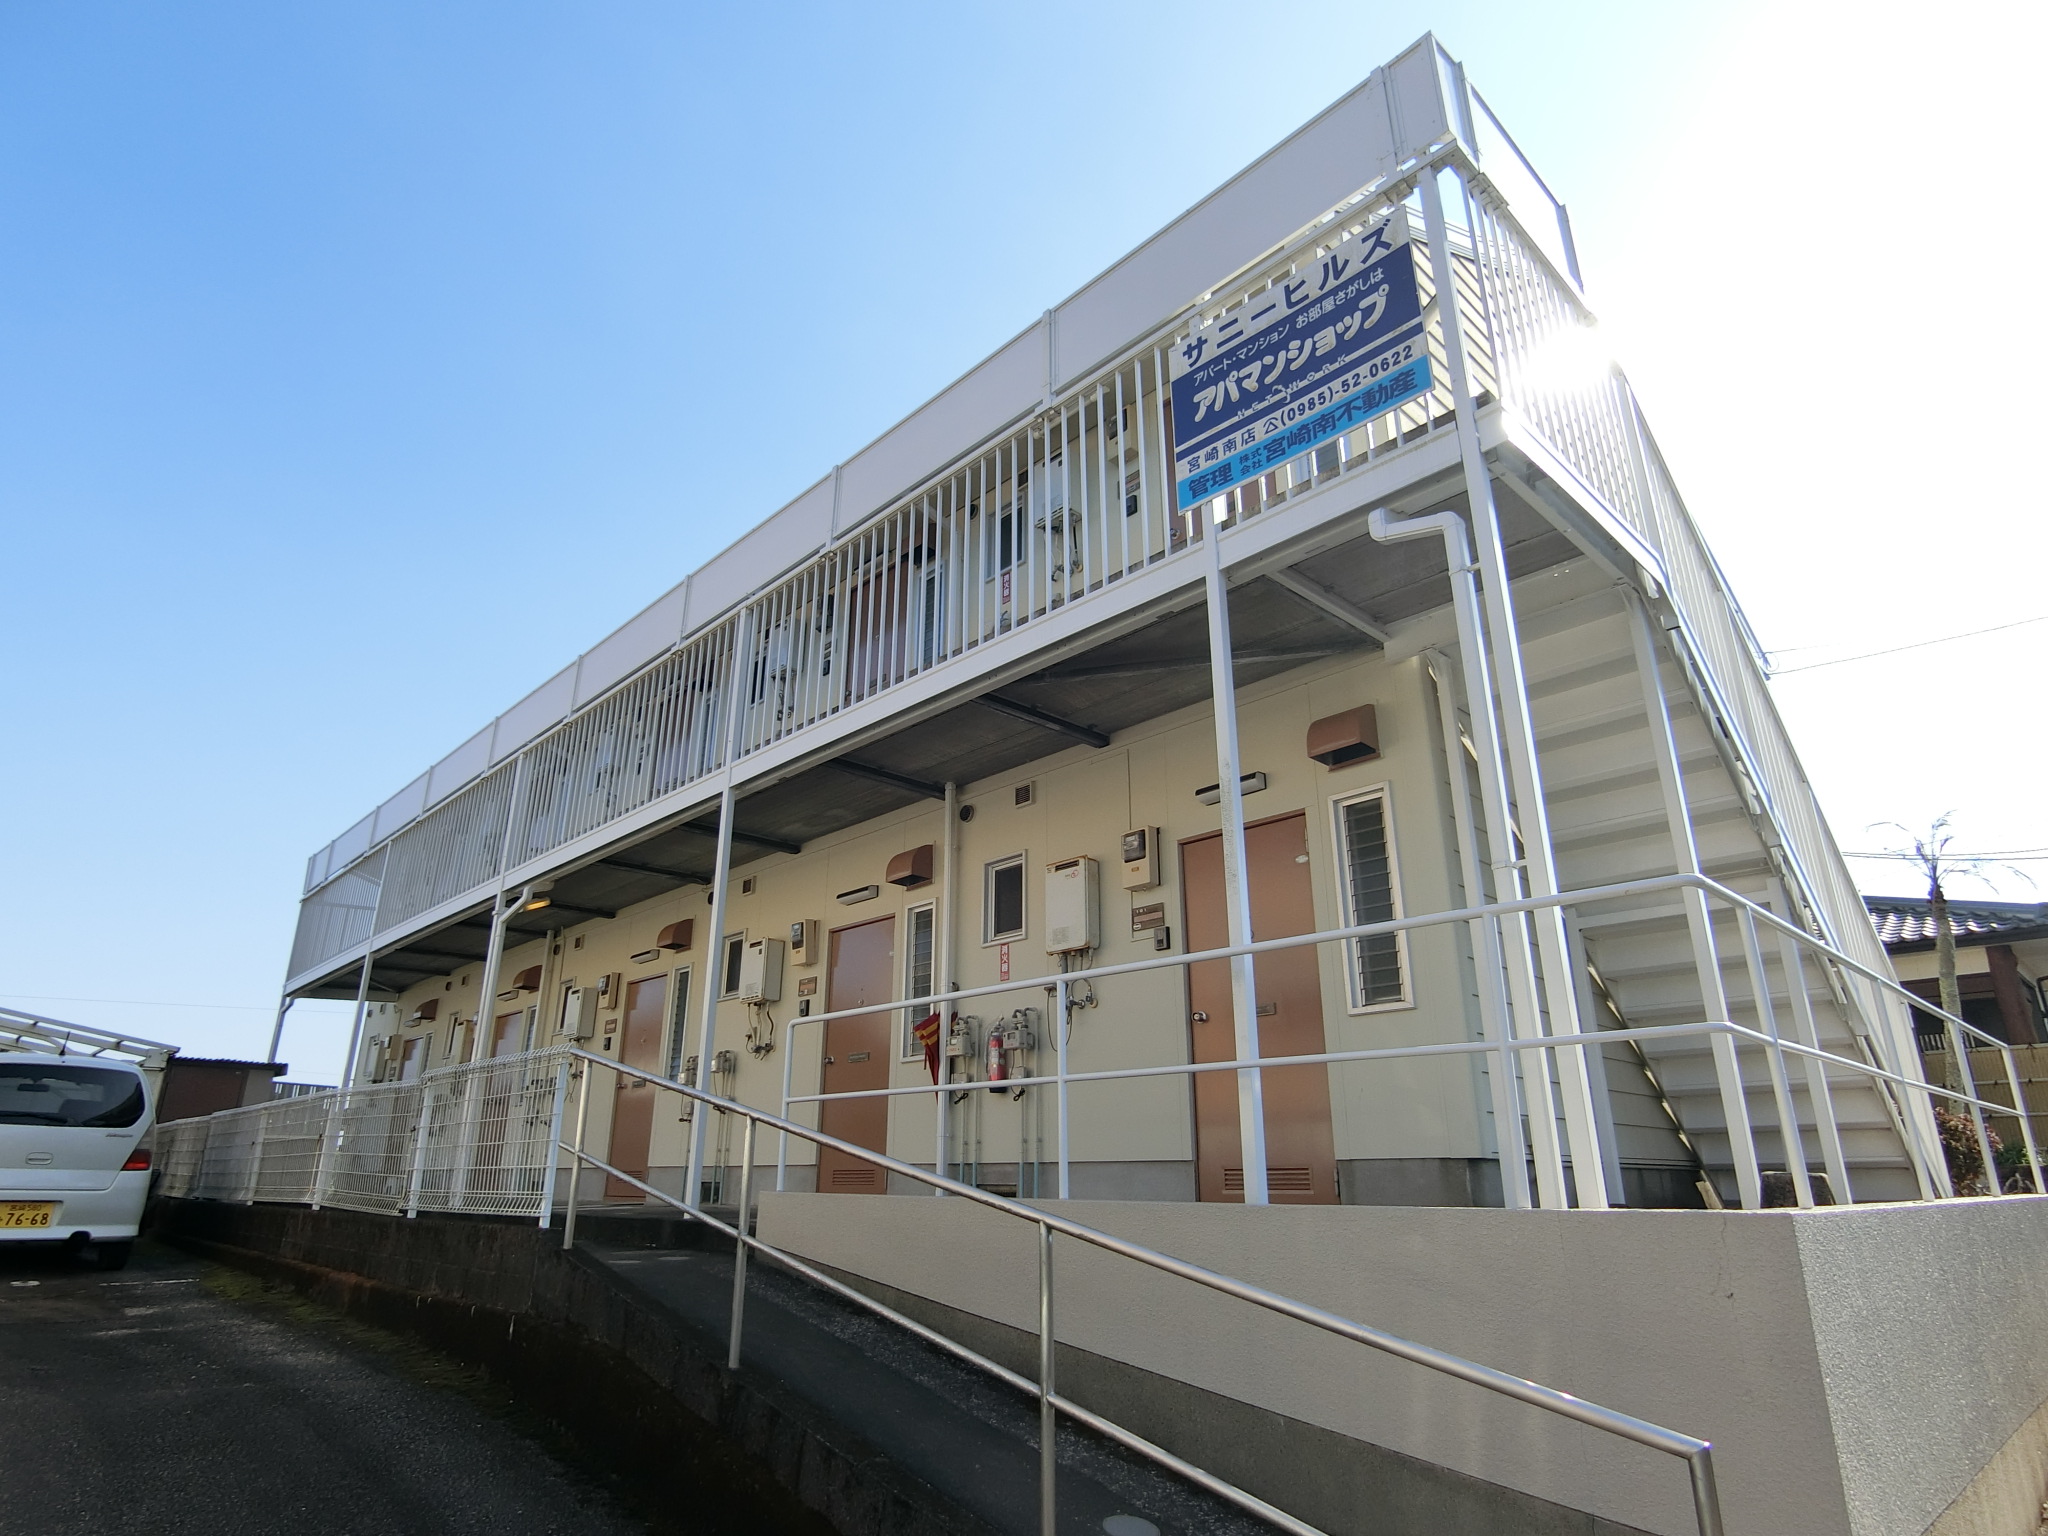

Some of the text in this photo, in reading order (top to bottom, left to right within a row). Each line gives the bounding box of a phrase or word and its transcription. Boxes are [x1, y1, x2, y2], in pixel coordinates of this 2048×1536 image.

[1182, 218, 1393, 369] サニーヒルズ
[1295, 267, 1385, 328] お部屋さがしは
[1193, 284, 1390, 422] アパマンショップ
[1187, 427, 1256, 474] 宮崎南店
[1188, 462, 1234, 499] 管理
[1263, 368, 1418, 463] 宮崎南不動産
[5, 1212, 49, 1226] 76-68
